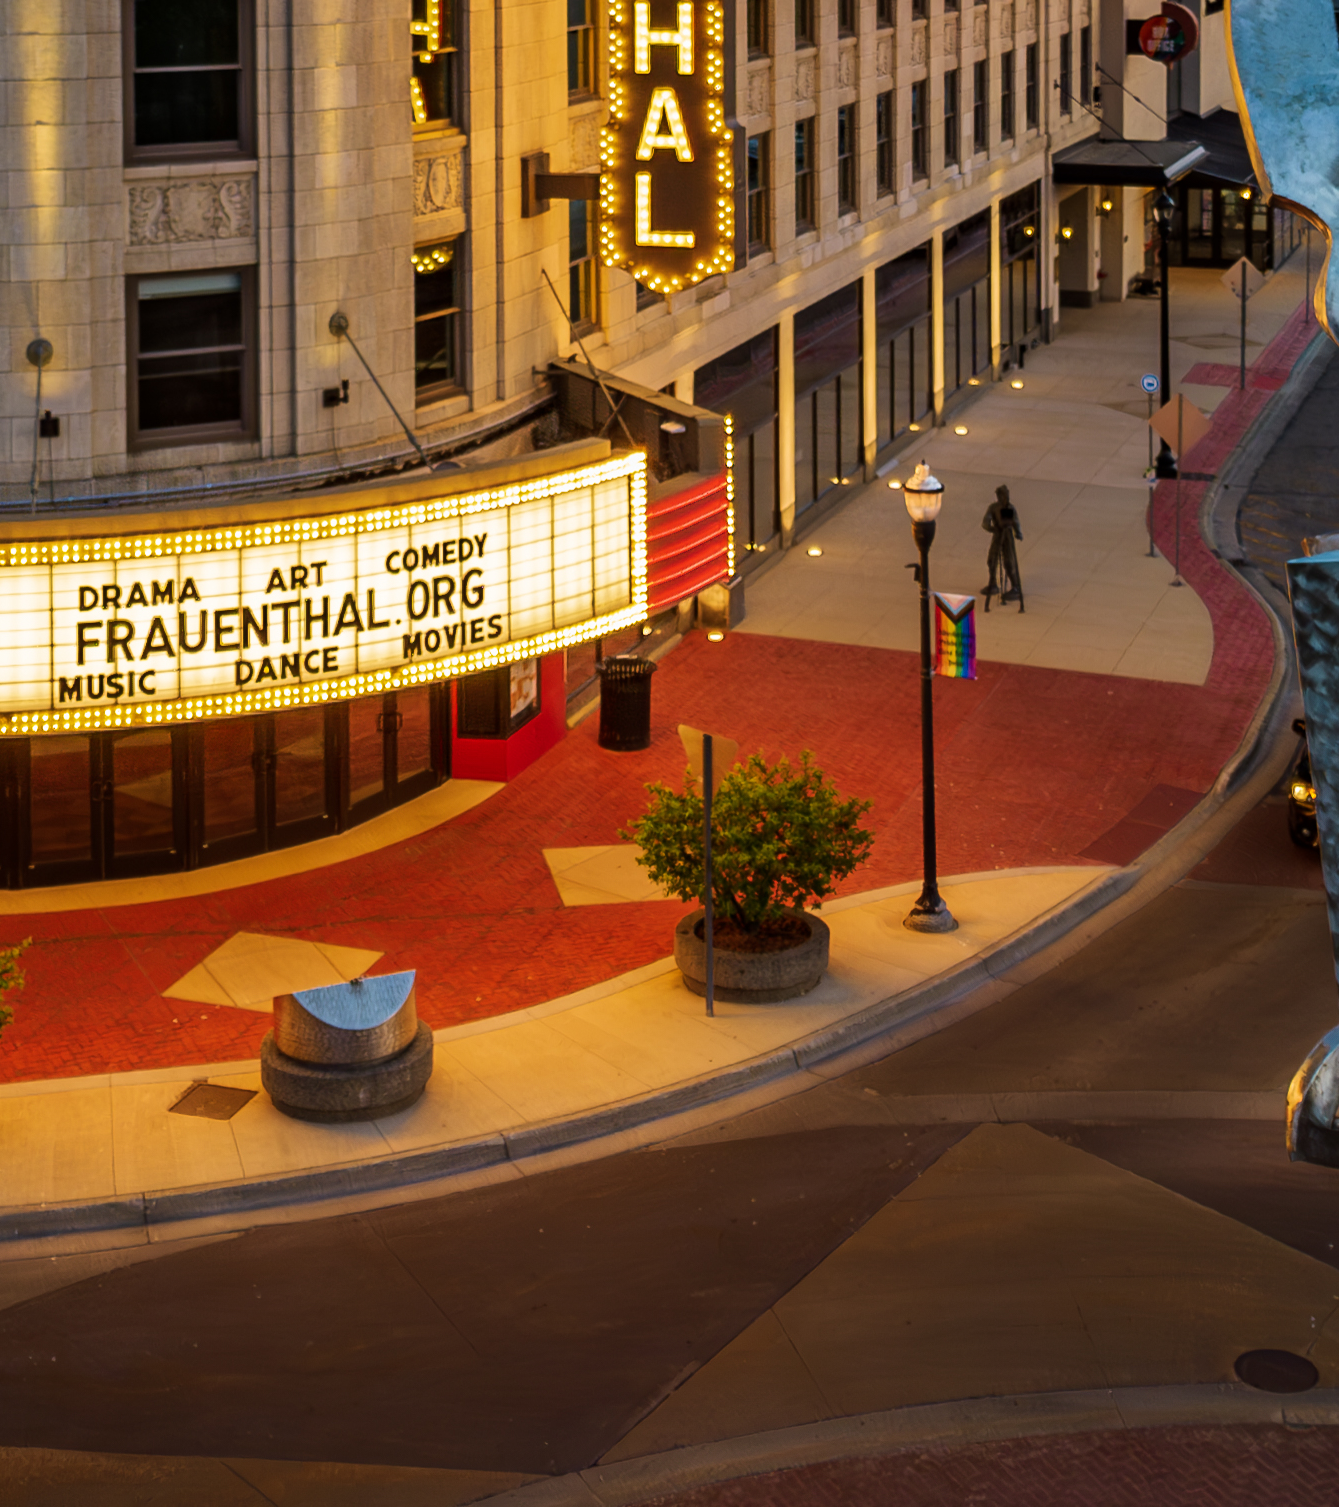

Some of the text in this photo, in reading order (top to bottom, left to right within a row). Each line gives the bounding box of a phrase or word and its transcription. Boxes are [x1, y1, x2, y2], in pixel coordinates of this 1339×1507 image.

[79, 532, 488, 612] DRAMA ART COMEDY
[59, 614, 503, 702] MUSIC DANCE MOVIES
[77, 568, 485, 665] FRAUENTHAL.ORG
